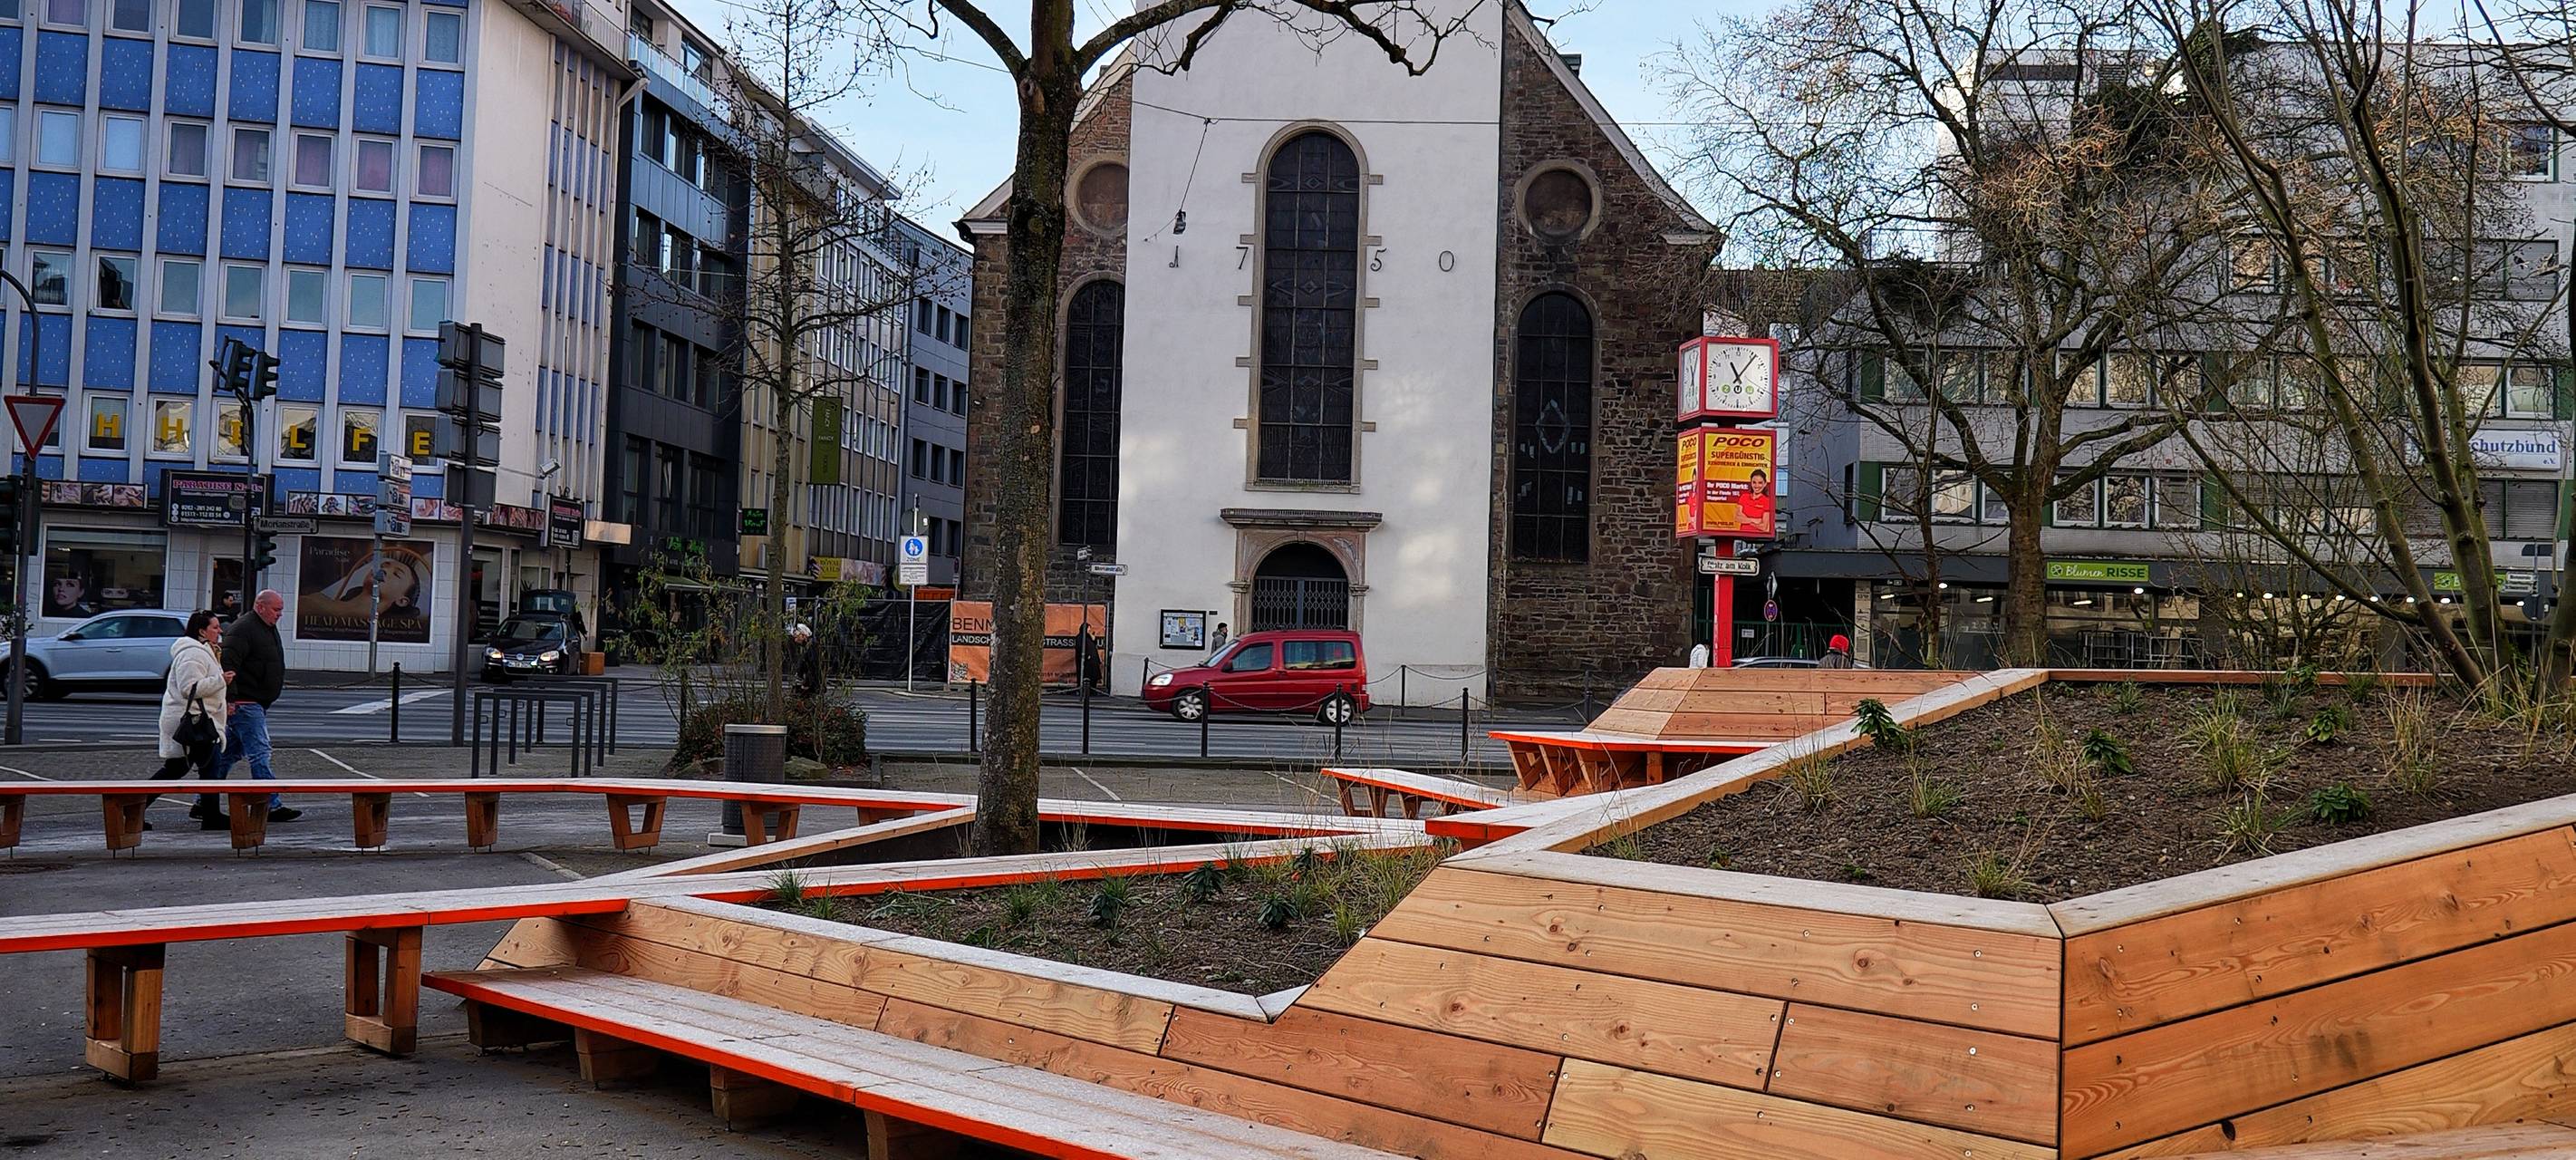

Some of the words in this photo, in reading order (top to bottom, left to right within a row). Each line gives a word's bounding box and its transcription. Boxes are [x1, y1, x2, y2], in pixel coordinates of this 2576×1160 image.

[1682, 437, 1697, 450] POCO
[1713, 437, 1765, 448] POCO
[2471, 439, 2556, 453] chutzbund
[1711, 451, 1765, 460] SUPERGÜNSTIG
[172, 479, 232, 490] PARADISE
[234, 482, 263, 493] Nals
[260, 519, 310, 529] Morianstraße
[308, 546, 351, 556] Paradise
[1737, 562, 1751, 570] Kolk
[2066, 565, 2105, 577] Blumen
[2106, 567, 2146, 578] RISSE
[398, 619, 422, 630] SPA
[952, 617, 993, 632] BENN
[951, 634, 991, 644] LANDSCH
